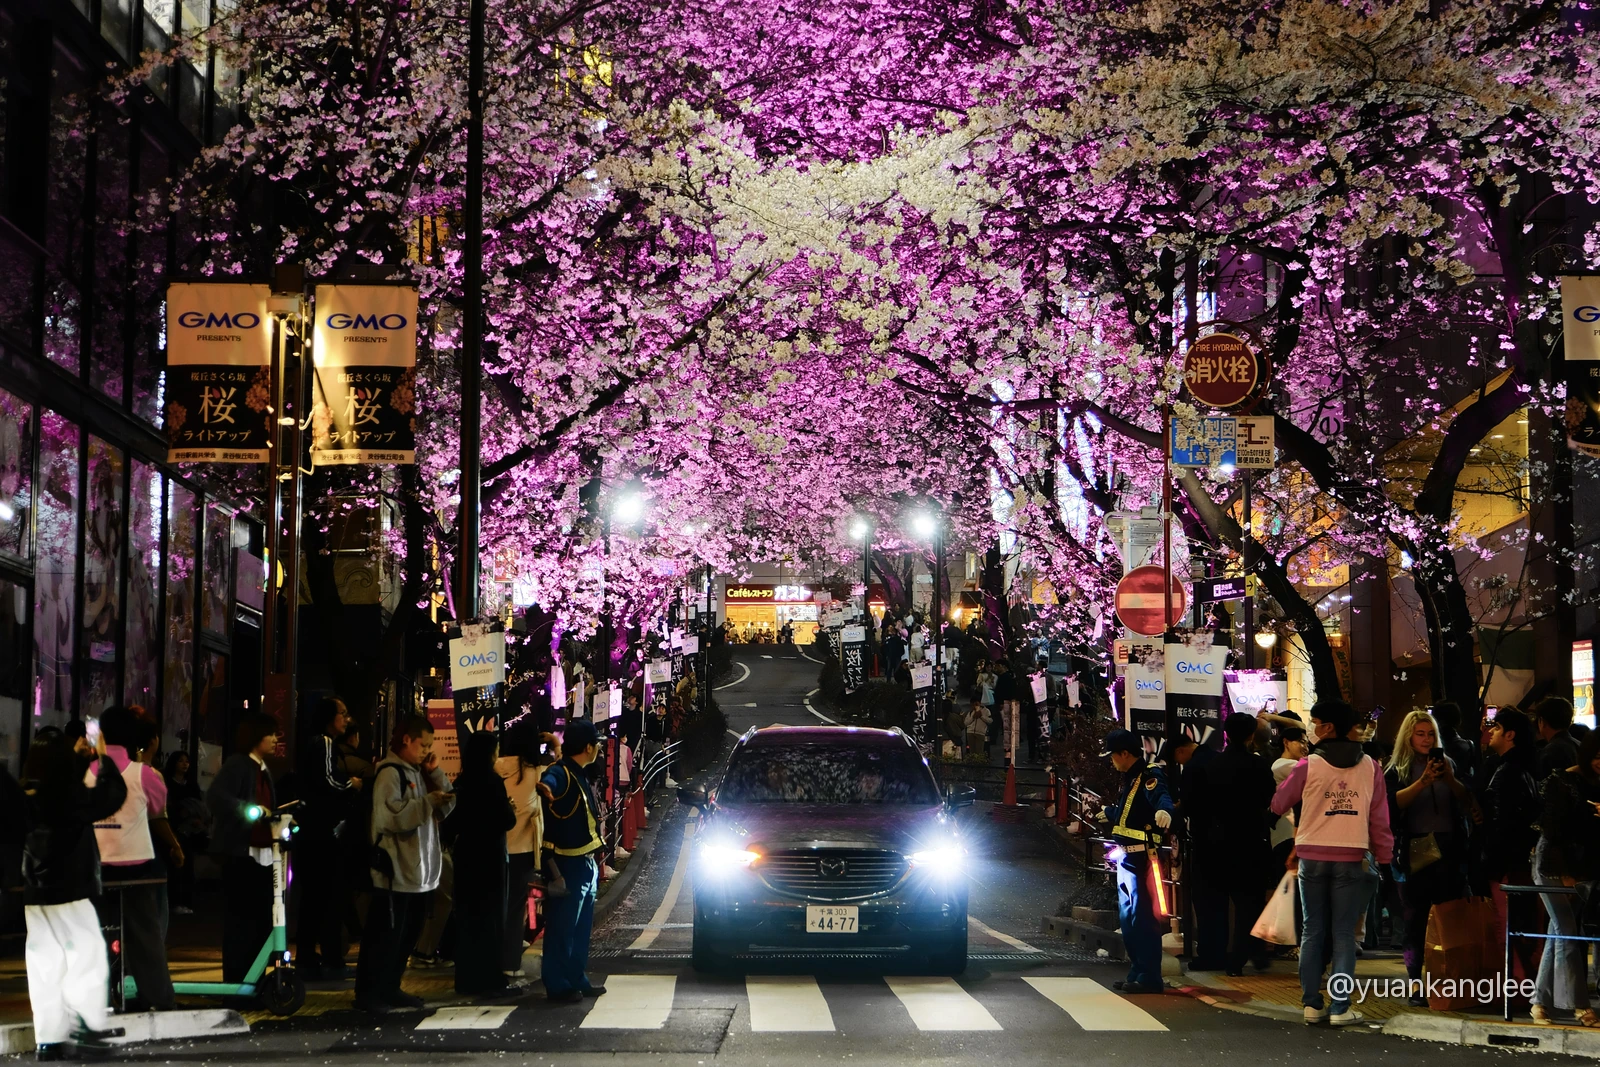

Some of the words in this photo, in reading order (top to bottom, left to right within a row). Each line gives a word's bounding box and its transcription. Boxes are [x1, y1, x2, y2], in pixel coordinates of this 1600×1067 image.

[178, 312, 259, 328] GMO
[327, 314, 406, 330] GMO
[1196, 344, 1210, 352] FIRE
[1212, 344, 1242, 352] HYDRANT
[1190, 356, 1250, 383] 消火栓
[191, 372, 246, 382] 桜丘さくら坂
[337, 373, 391, 383] 桜丘さくら坂
[198, 386, 237, 424] 桜
[344, 387, 382, 425] 桜
[184, 431, 251, 441] ライトアップ
[330, 431, 396, 443] ライトアップ
[774, 586, 812, 600] ガスト
[1325, 790, 1359, 798] SAKURA
[818, 917, 855, 930] 44-77
